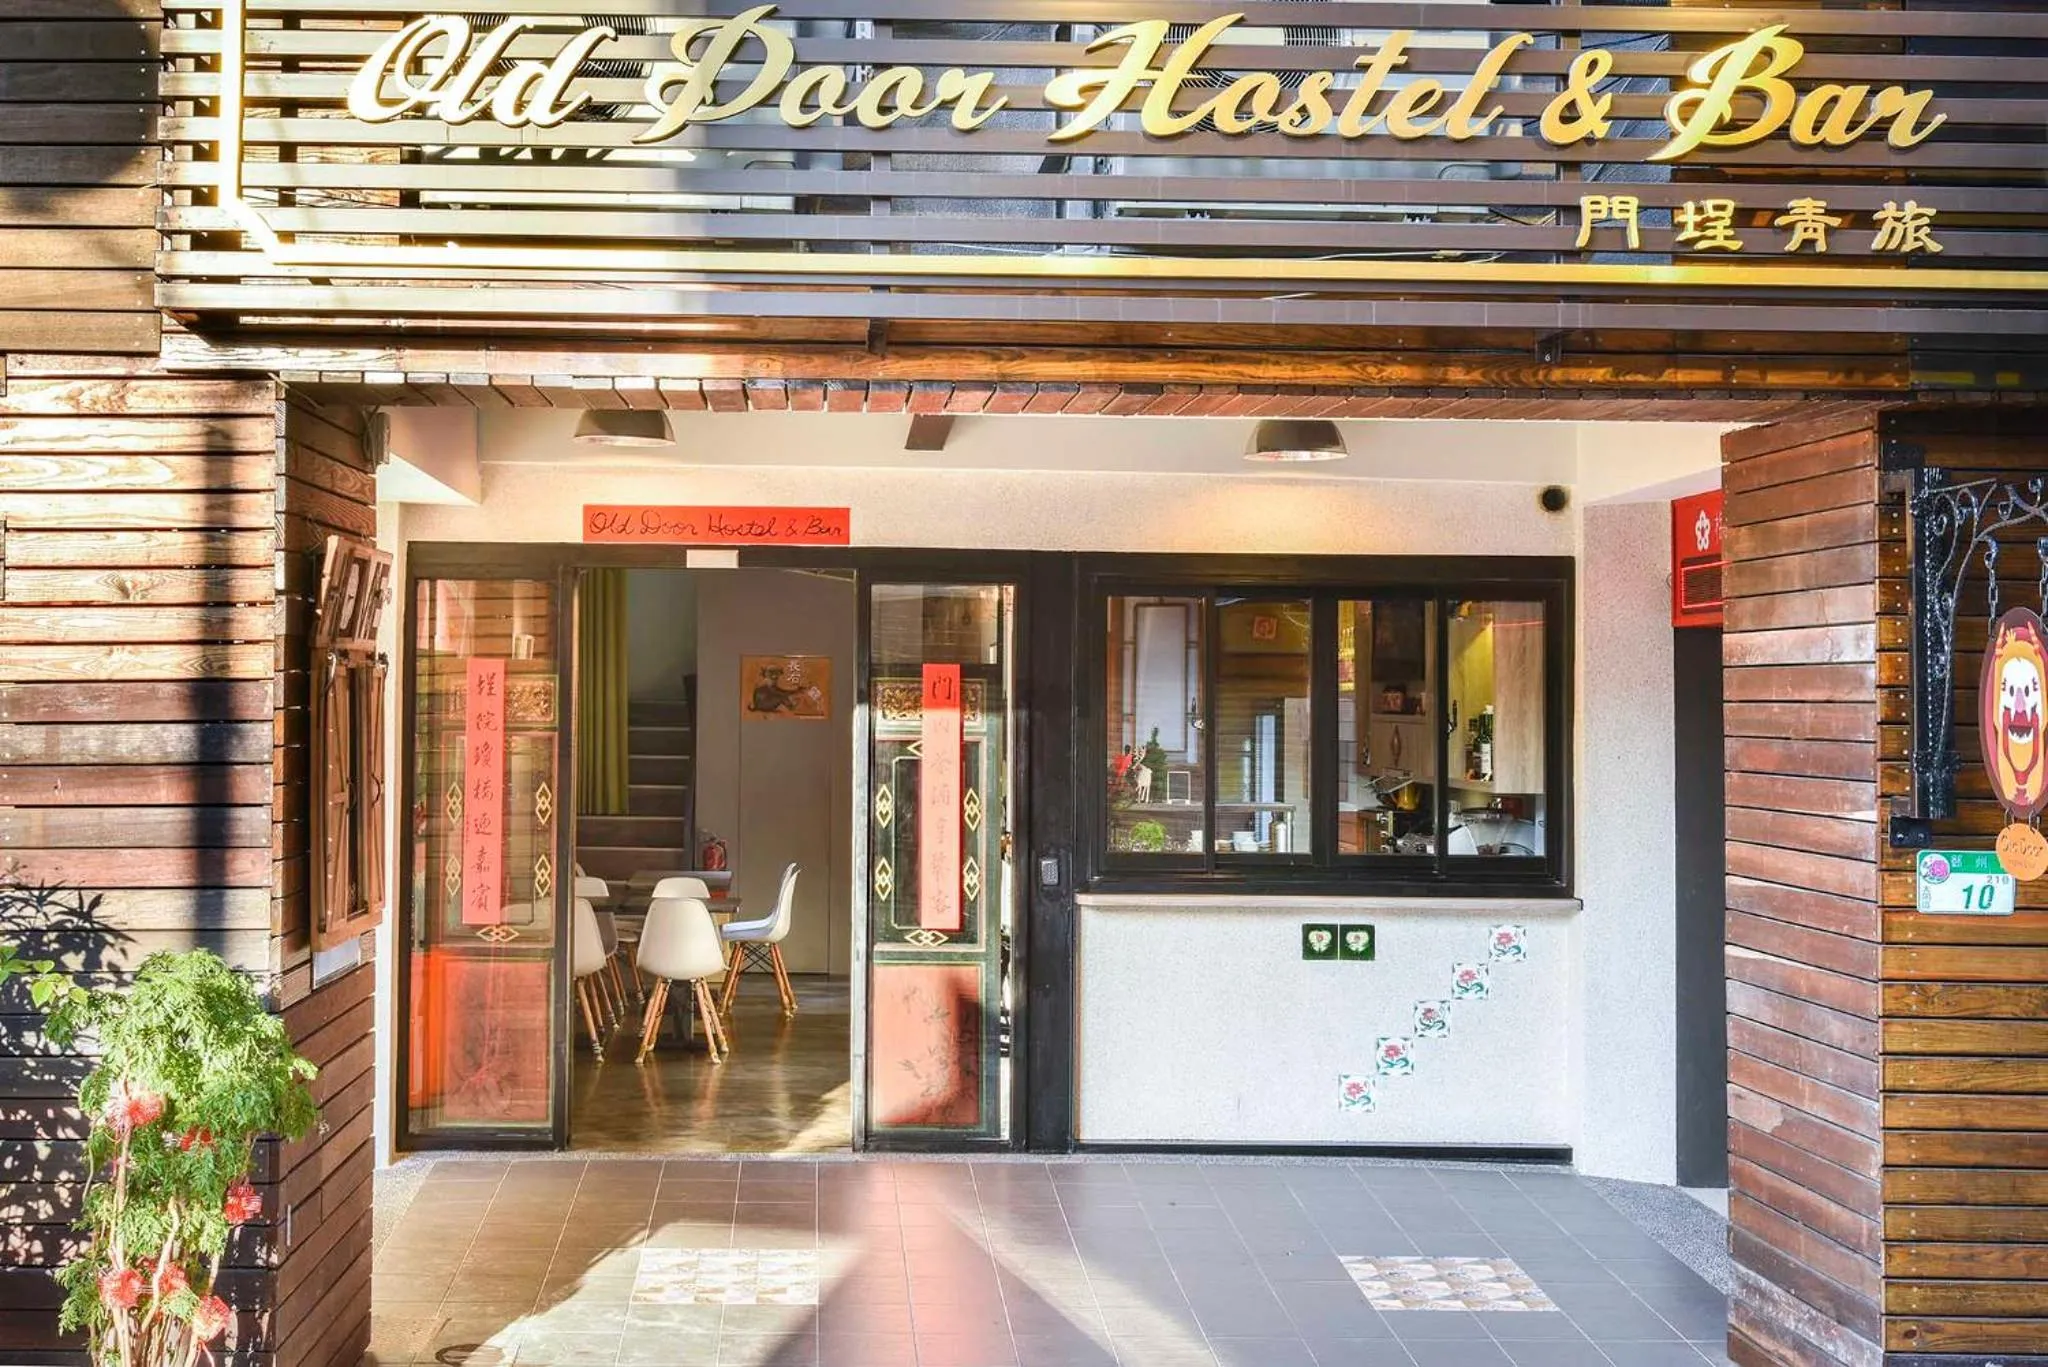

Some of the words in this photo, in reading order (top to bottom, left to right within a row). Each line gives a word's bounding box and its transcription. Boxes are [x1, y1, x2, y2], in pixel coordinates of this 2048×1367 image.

[347, 14, 617, 128] Old
[631, 4, 1008, 144] Door
[1043, 11, 1534, 143] Hostel
[1540, 48, 1615, 146] &
[1647, 23, 1948, 161] Bar
[1575, 195, 1943, 253] 門埕青旅
[589, 511, 634, 535] Old
[640, 509, 699, 536] Door
[707, 512, 778, 538] Hostel
[785, 518, 799, 537] &
[804, 514, 842, 537] Bar
[1962, 884, 1995, 910] 10
